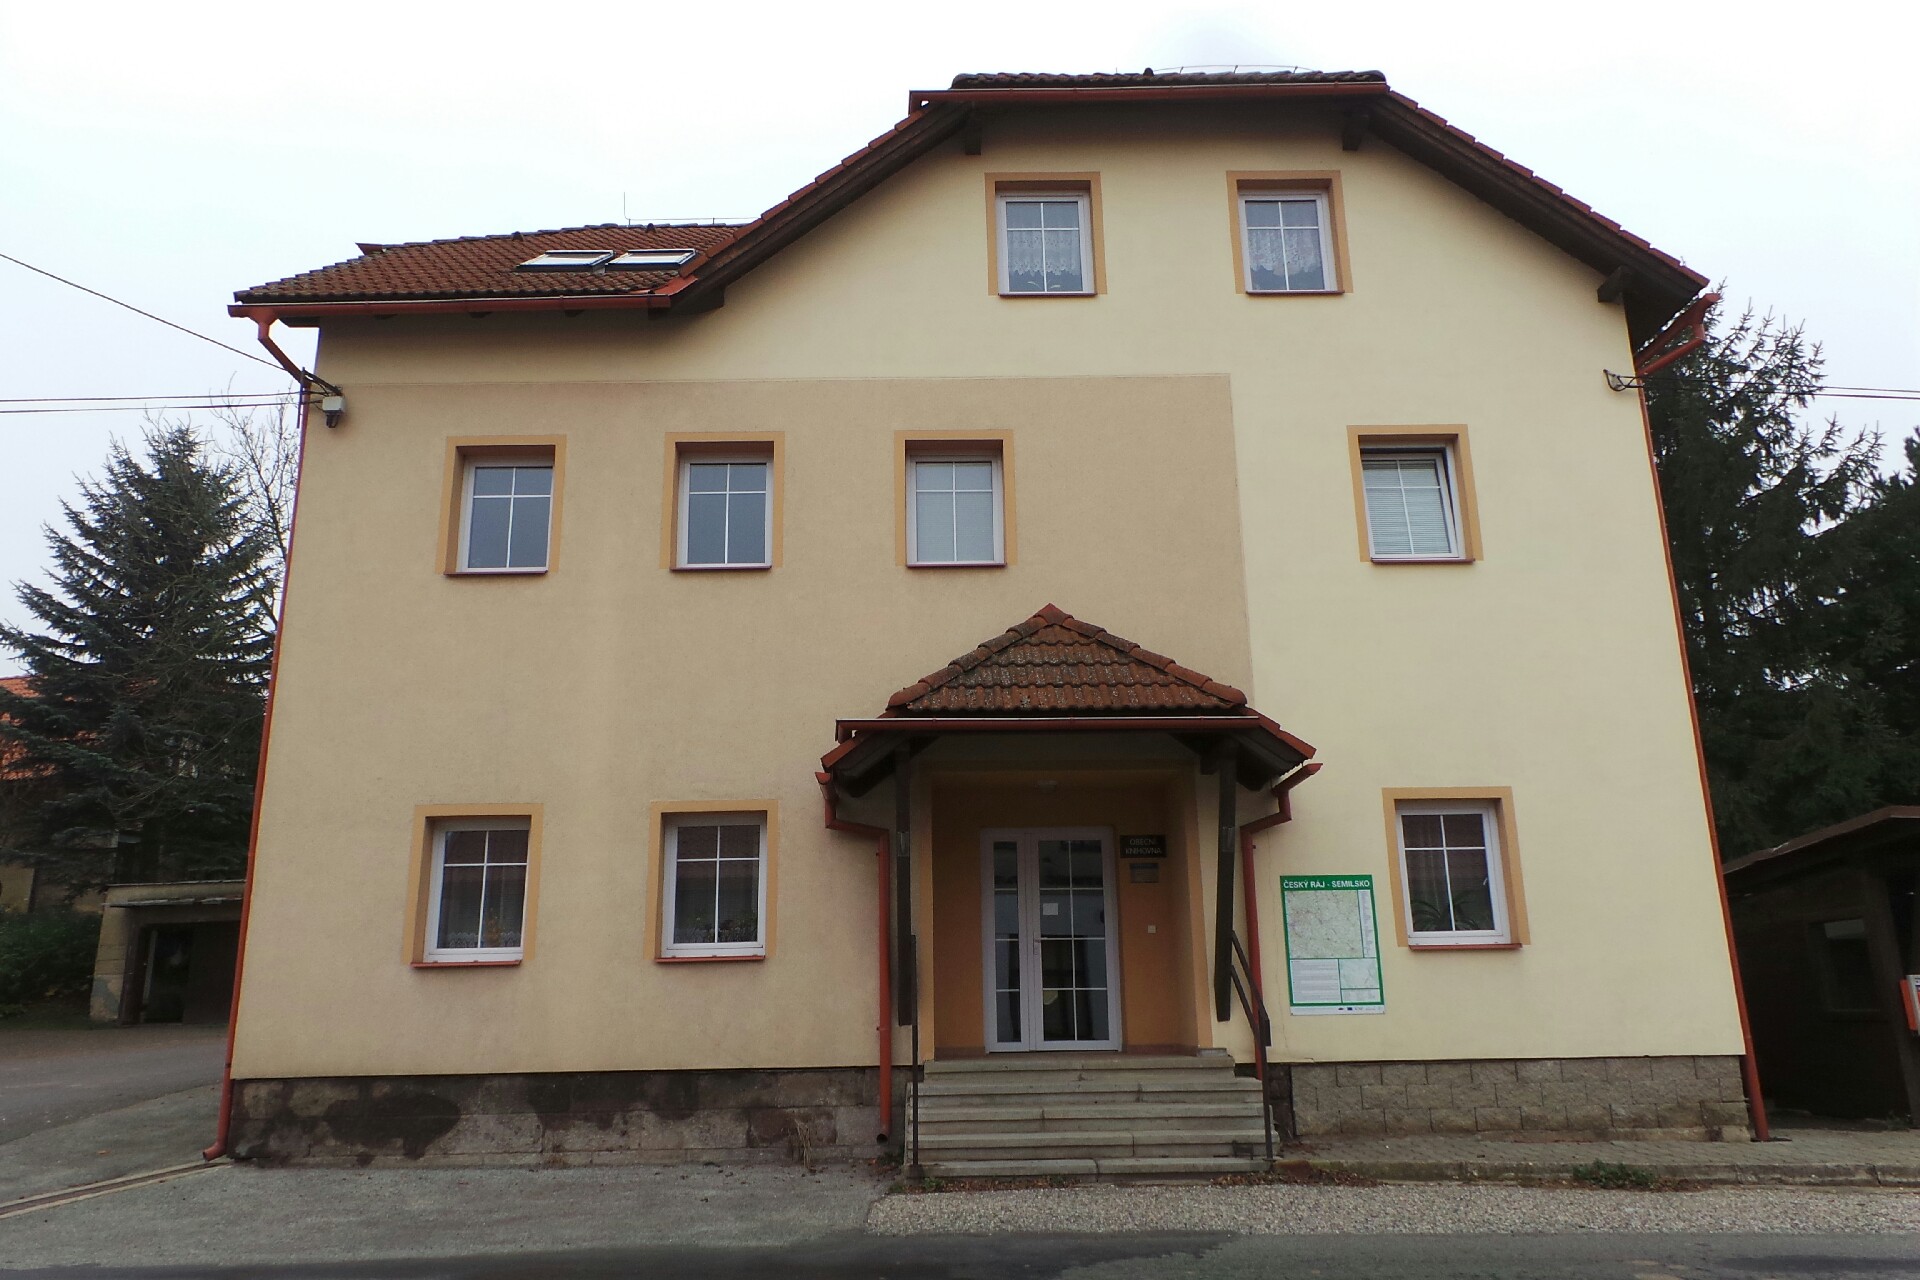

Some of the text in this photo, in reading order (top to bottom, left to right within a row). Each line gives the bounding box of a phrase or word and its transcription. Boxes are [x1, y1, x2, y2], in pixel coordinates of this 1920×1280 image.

[1125, 847, 1162, 855] KNIHOVNA
[1283, 879, 1308, 888] ČESKÝ
[1332, 879, 1370, 888] SEMILSKO
